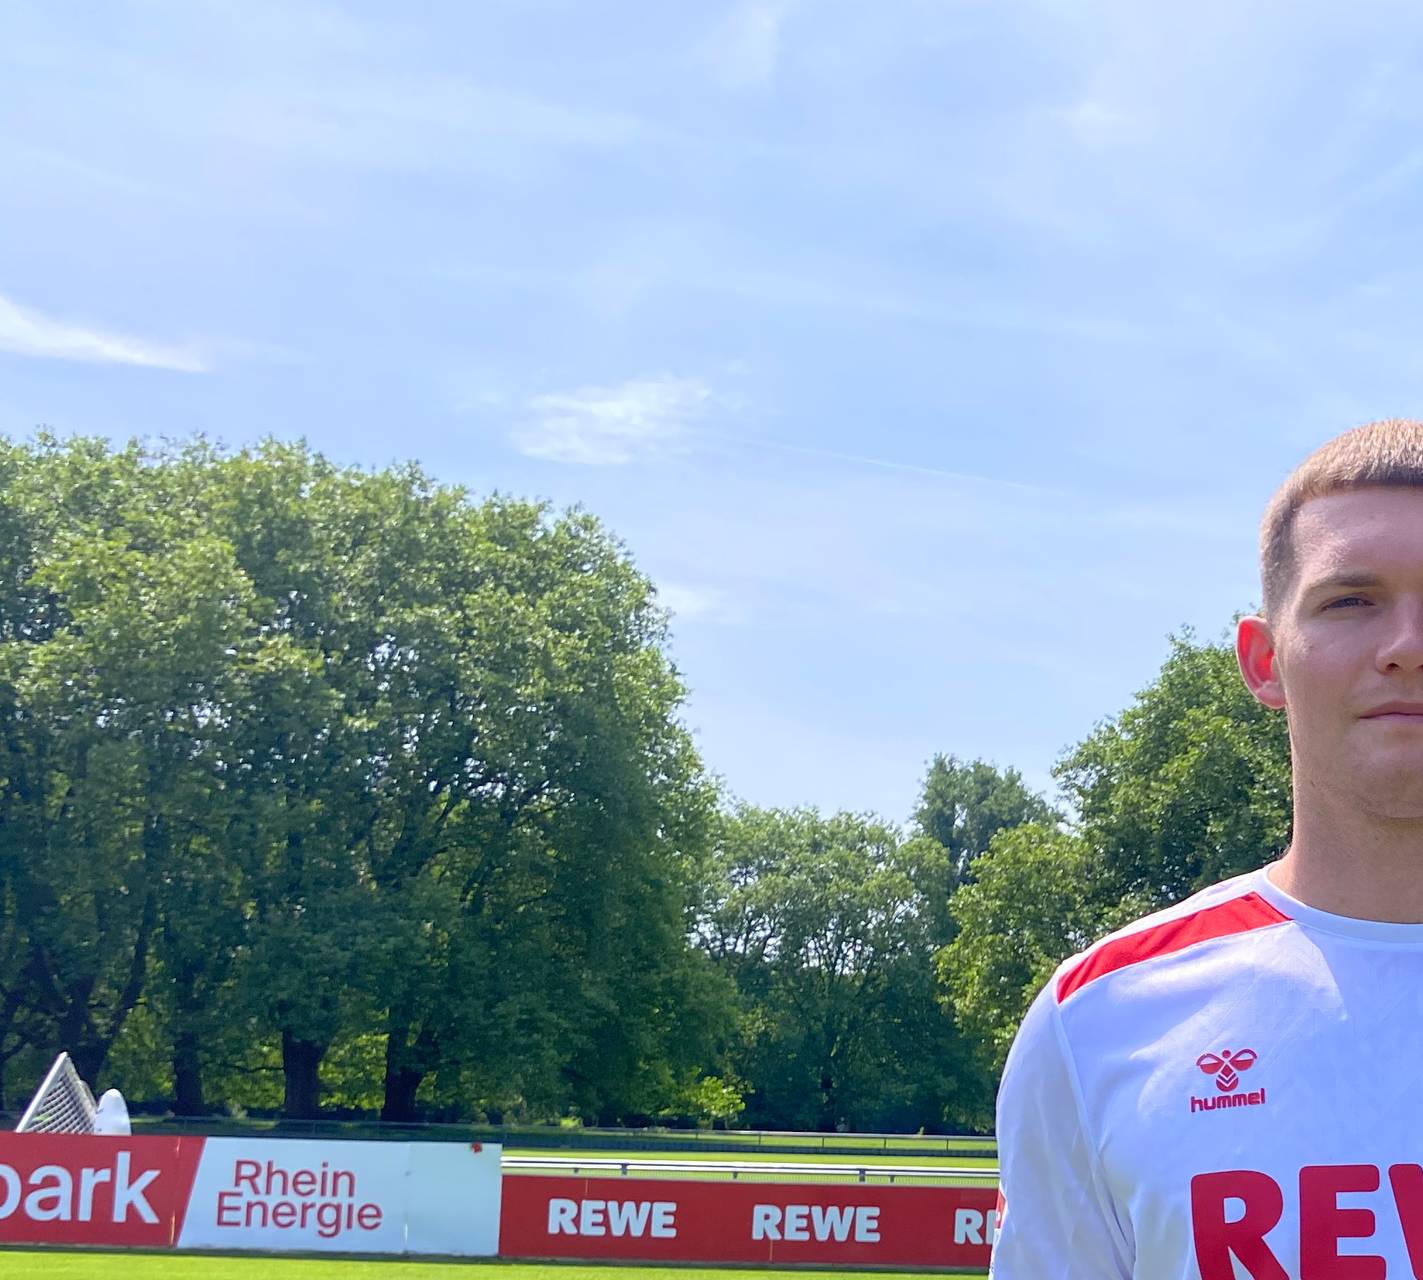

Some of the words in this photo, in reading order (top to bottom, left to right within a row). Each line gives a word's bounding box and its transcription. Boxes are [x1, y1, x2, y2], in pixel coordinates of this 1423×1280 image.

[1191, 1088, 1265, 1113] hummel
[234, 1160, 355, 1197] Rhein
[217, 1191, 383, 1238] Energie
[547, 1198, 677, 1238] REWE
[752, 1204, 881, 1242] REWE
